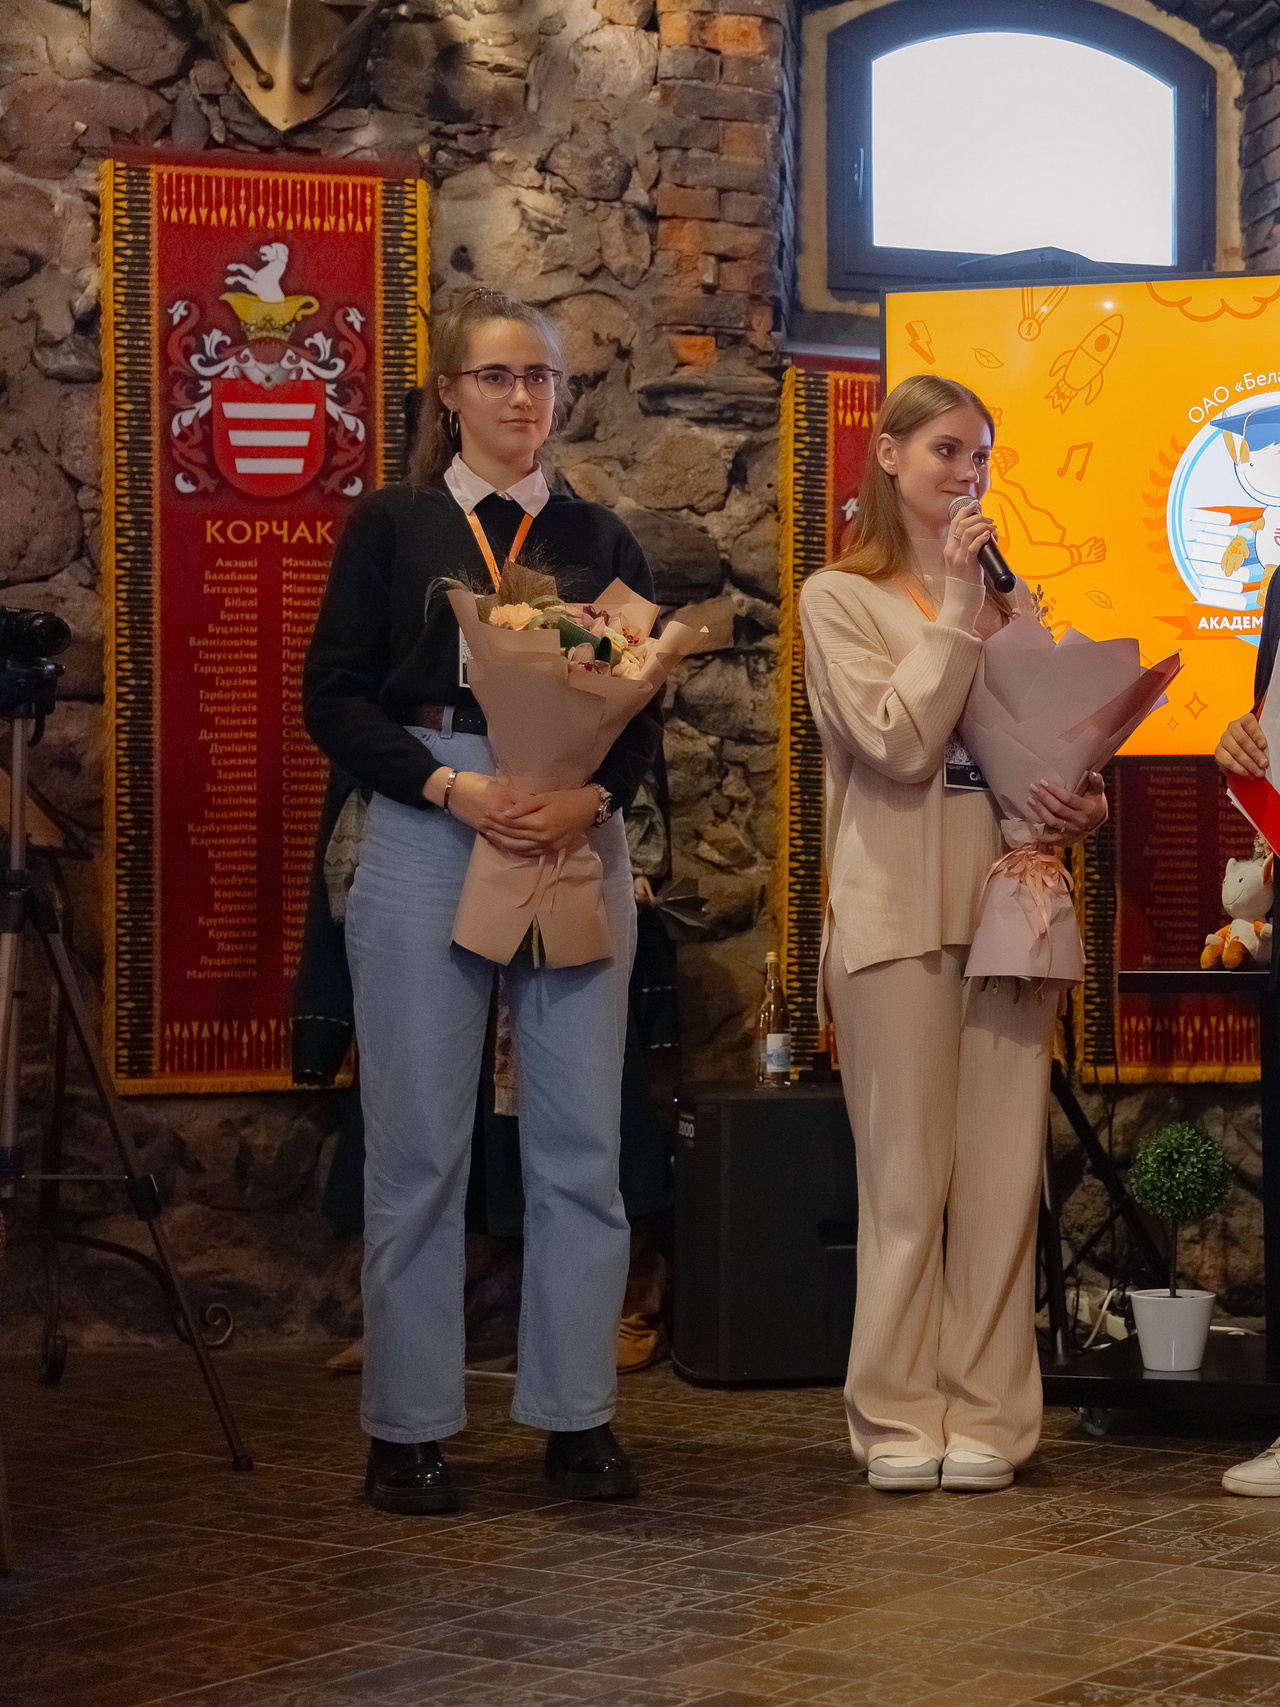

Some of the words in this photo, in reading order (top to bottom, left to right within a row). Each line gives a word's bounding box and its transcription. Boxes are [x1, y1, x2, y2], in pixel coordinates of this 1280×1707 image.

[1188, 386, 1230, 423] ОАО
[205, 519, 335, 544] КОРЧАК
[205, 570, 258, 581] Балабаны
[220, 610, 258, 622] Братко
